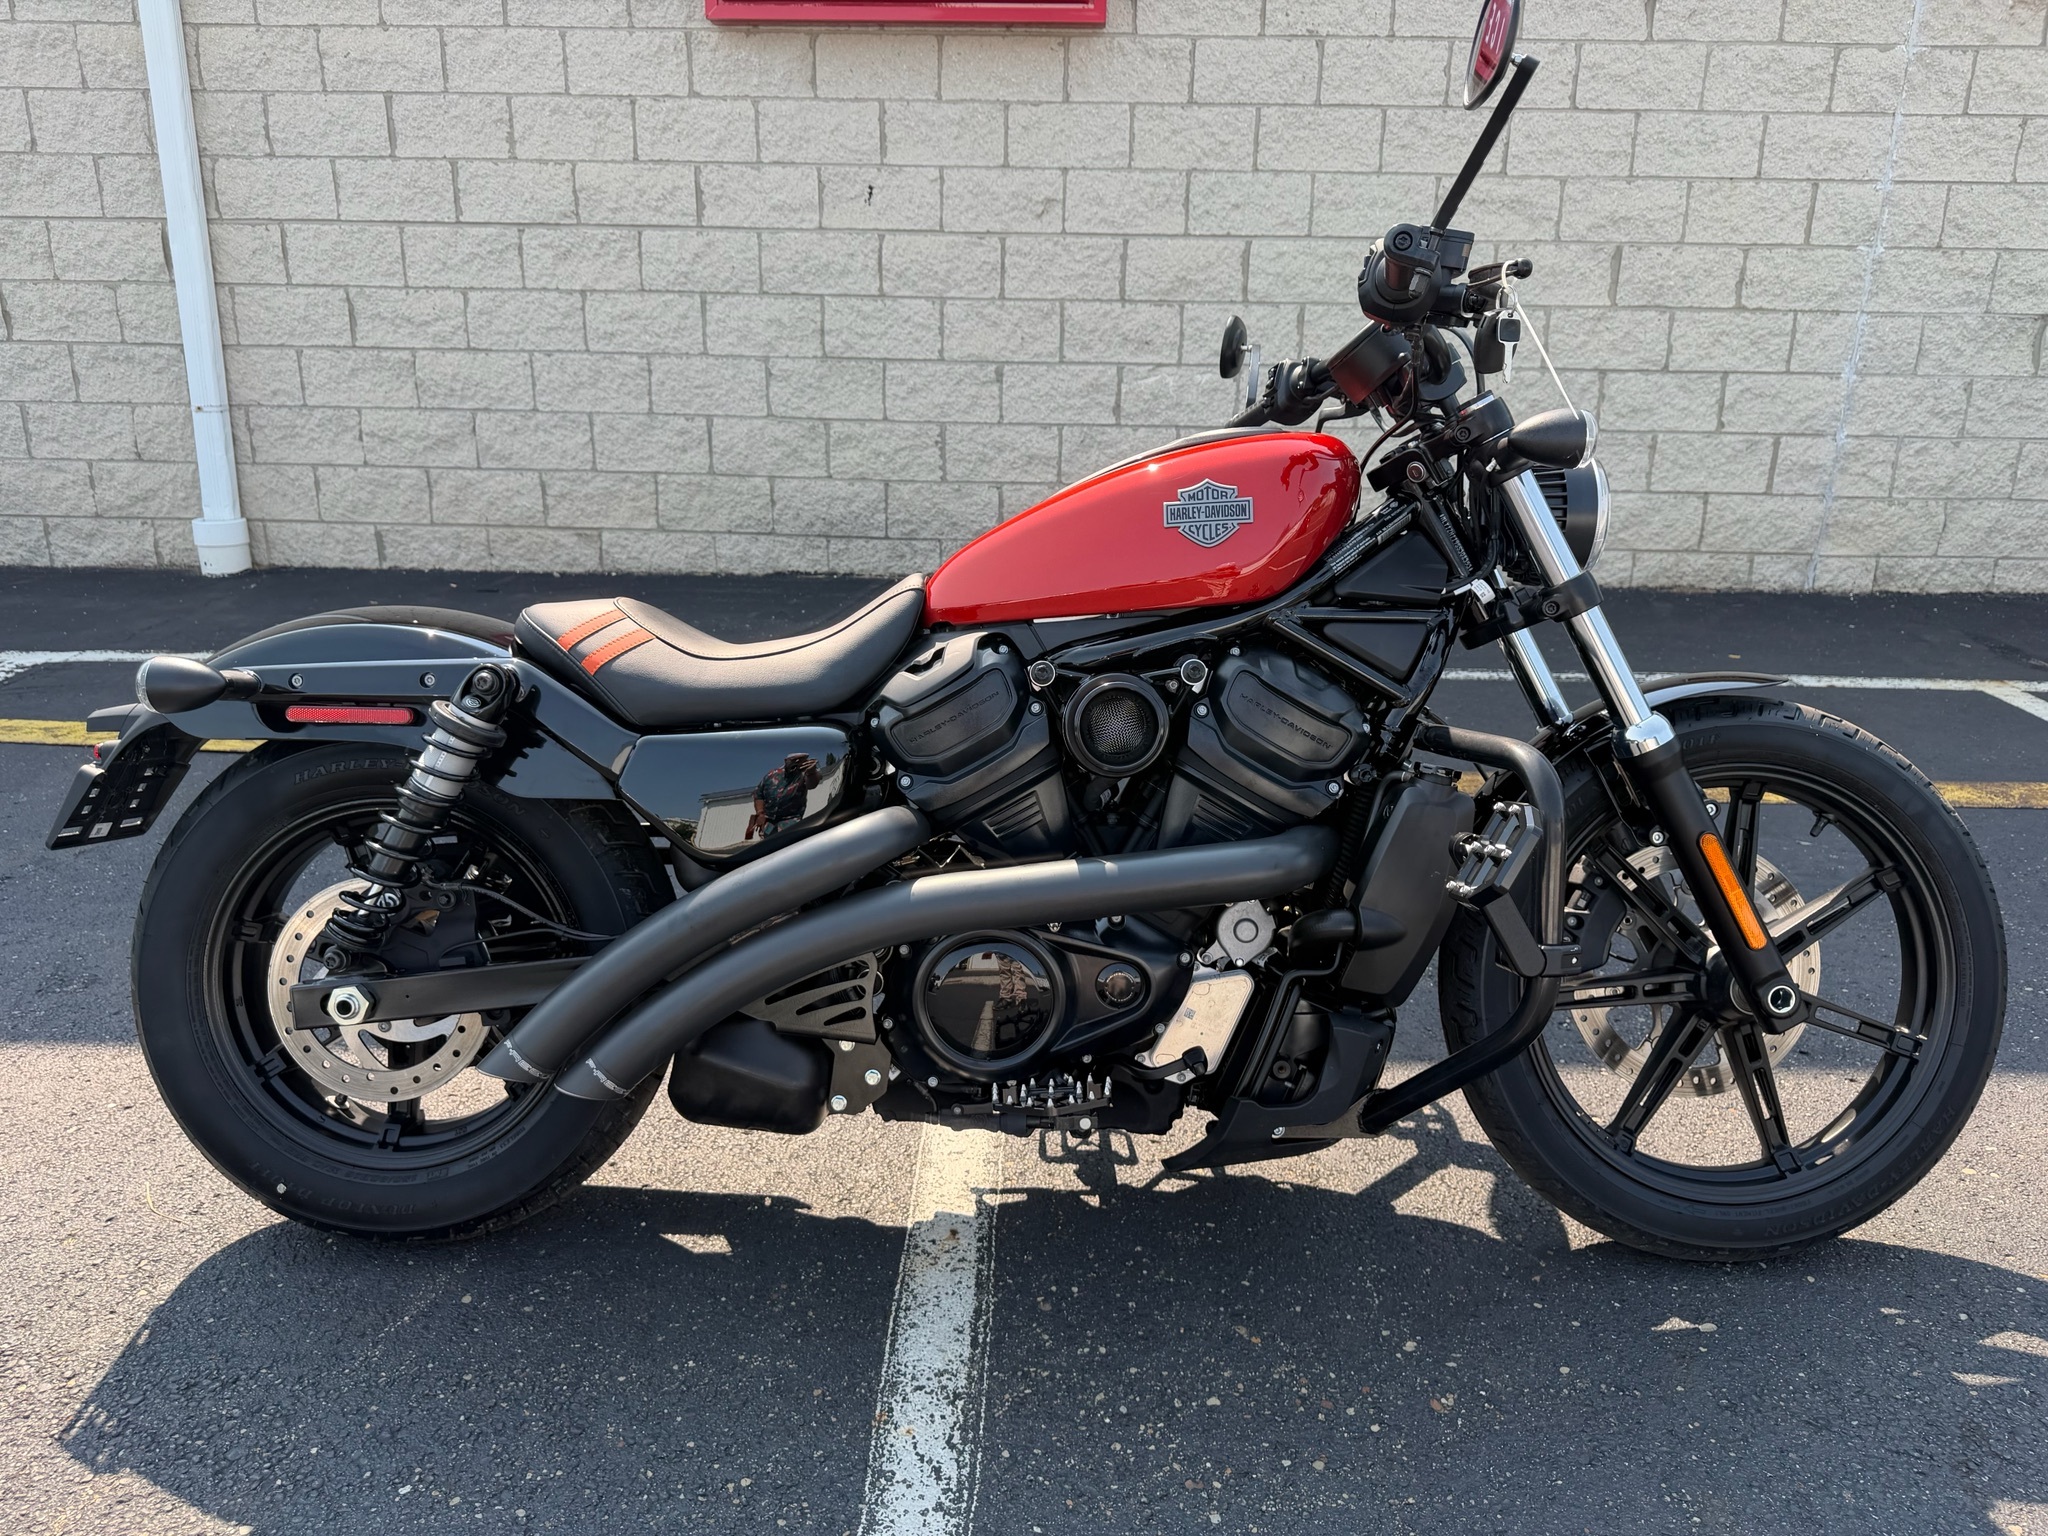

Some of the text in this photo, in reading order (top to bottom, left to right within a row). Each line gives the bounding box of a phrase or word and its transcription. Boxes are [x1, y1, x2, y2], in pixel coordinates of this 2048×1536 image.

[1187, 485, 1229, 502] MOTOR
[1169, 503, 1247, 521] HARLEY-DAVIDSON
[1188, 523, 1229, 541] CYCLES
[908, 690, 1001, 744] HARLEY-DAVIDSON
[1239, 692, 1332, 750] HARLEY-DAVIDSON
